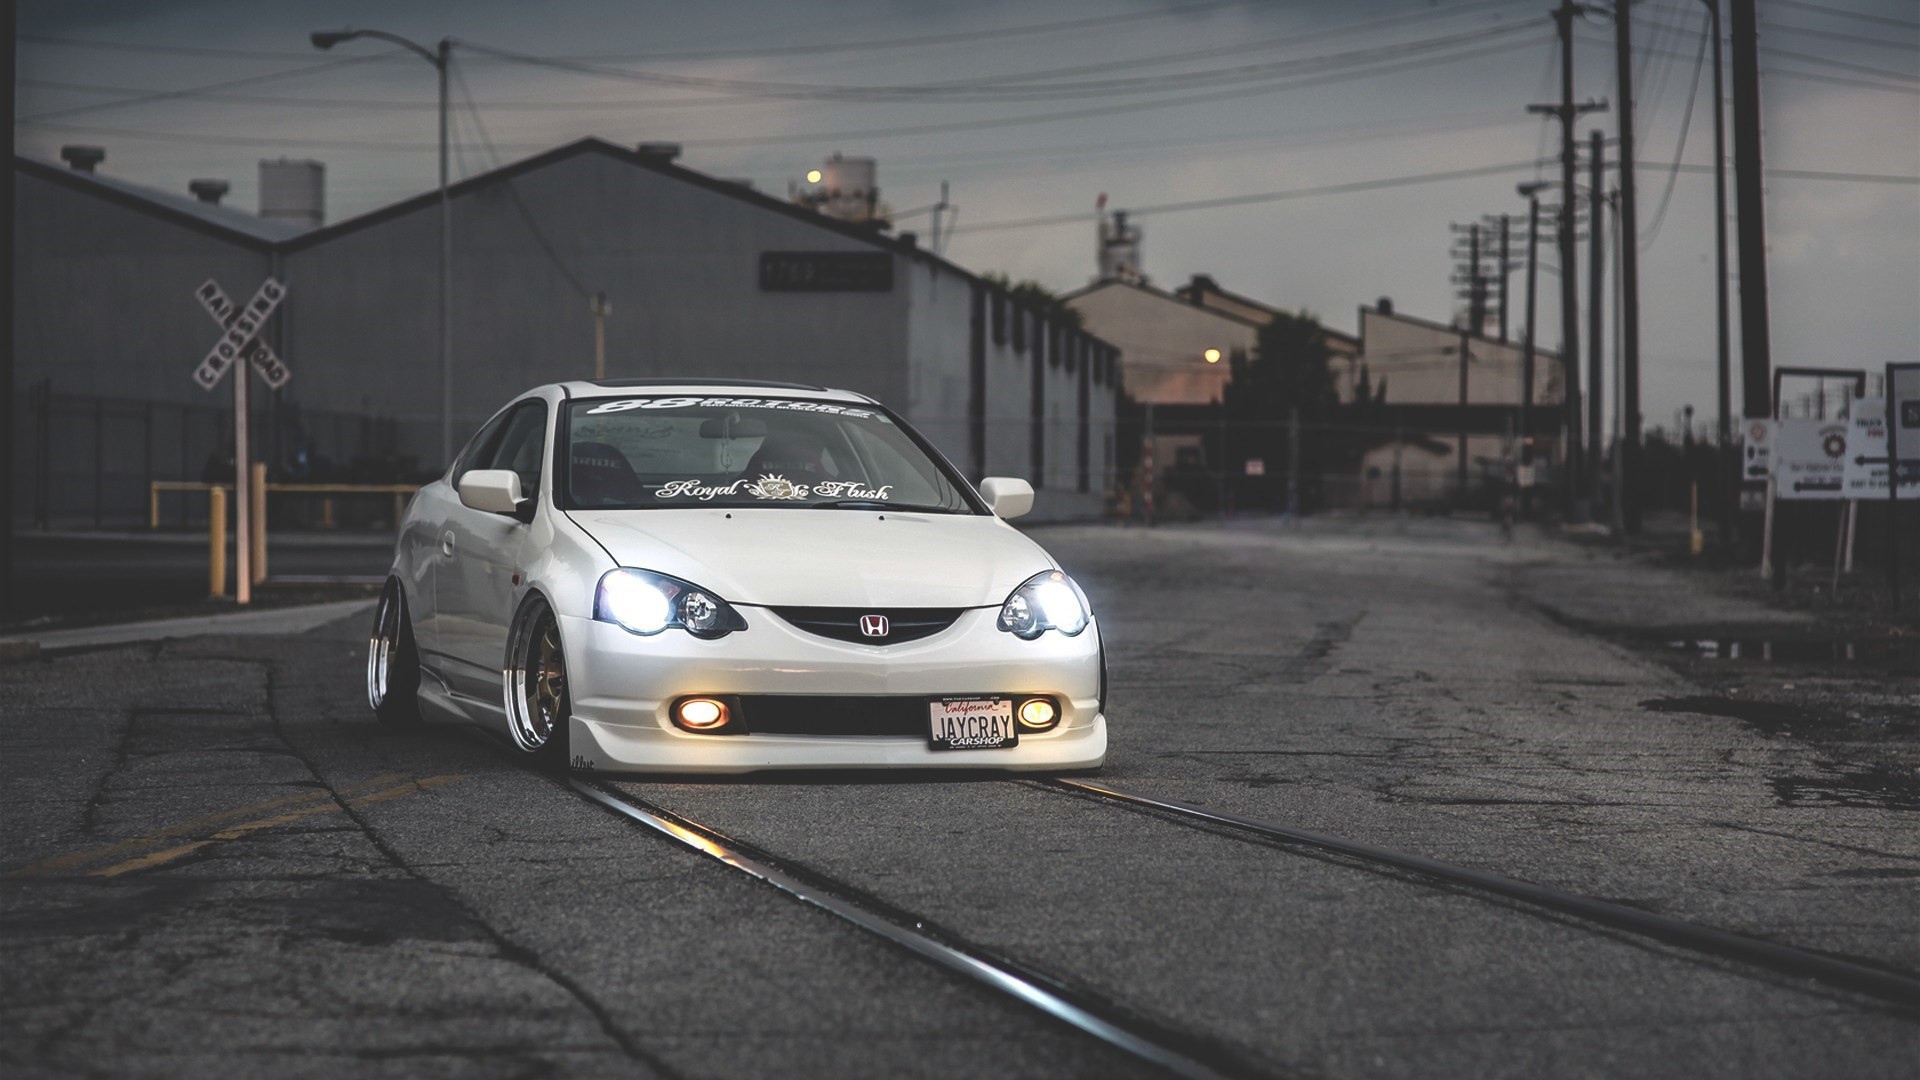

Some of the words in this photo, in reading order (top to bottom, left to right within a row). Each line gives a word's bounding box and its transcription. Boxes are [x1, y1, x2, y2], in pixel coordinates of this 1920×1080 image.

[199, 283, 280, 385] CROSSING
[655, 479, 748, 500] Royal
[813, 481, 893, 500] Flush
[945, 701, 999, 715] California
[936, 715, 1010, 740] JAYCRAY
[950, 737, 1004, 745] CARSHOP
